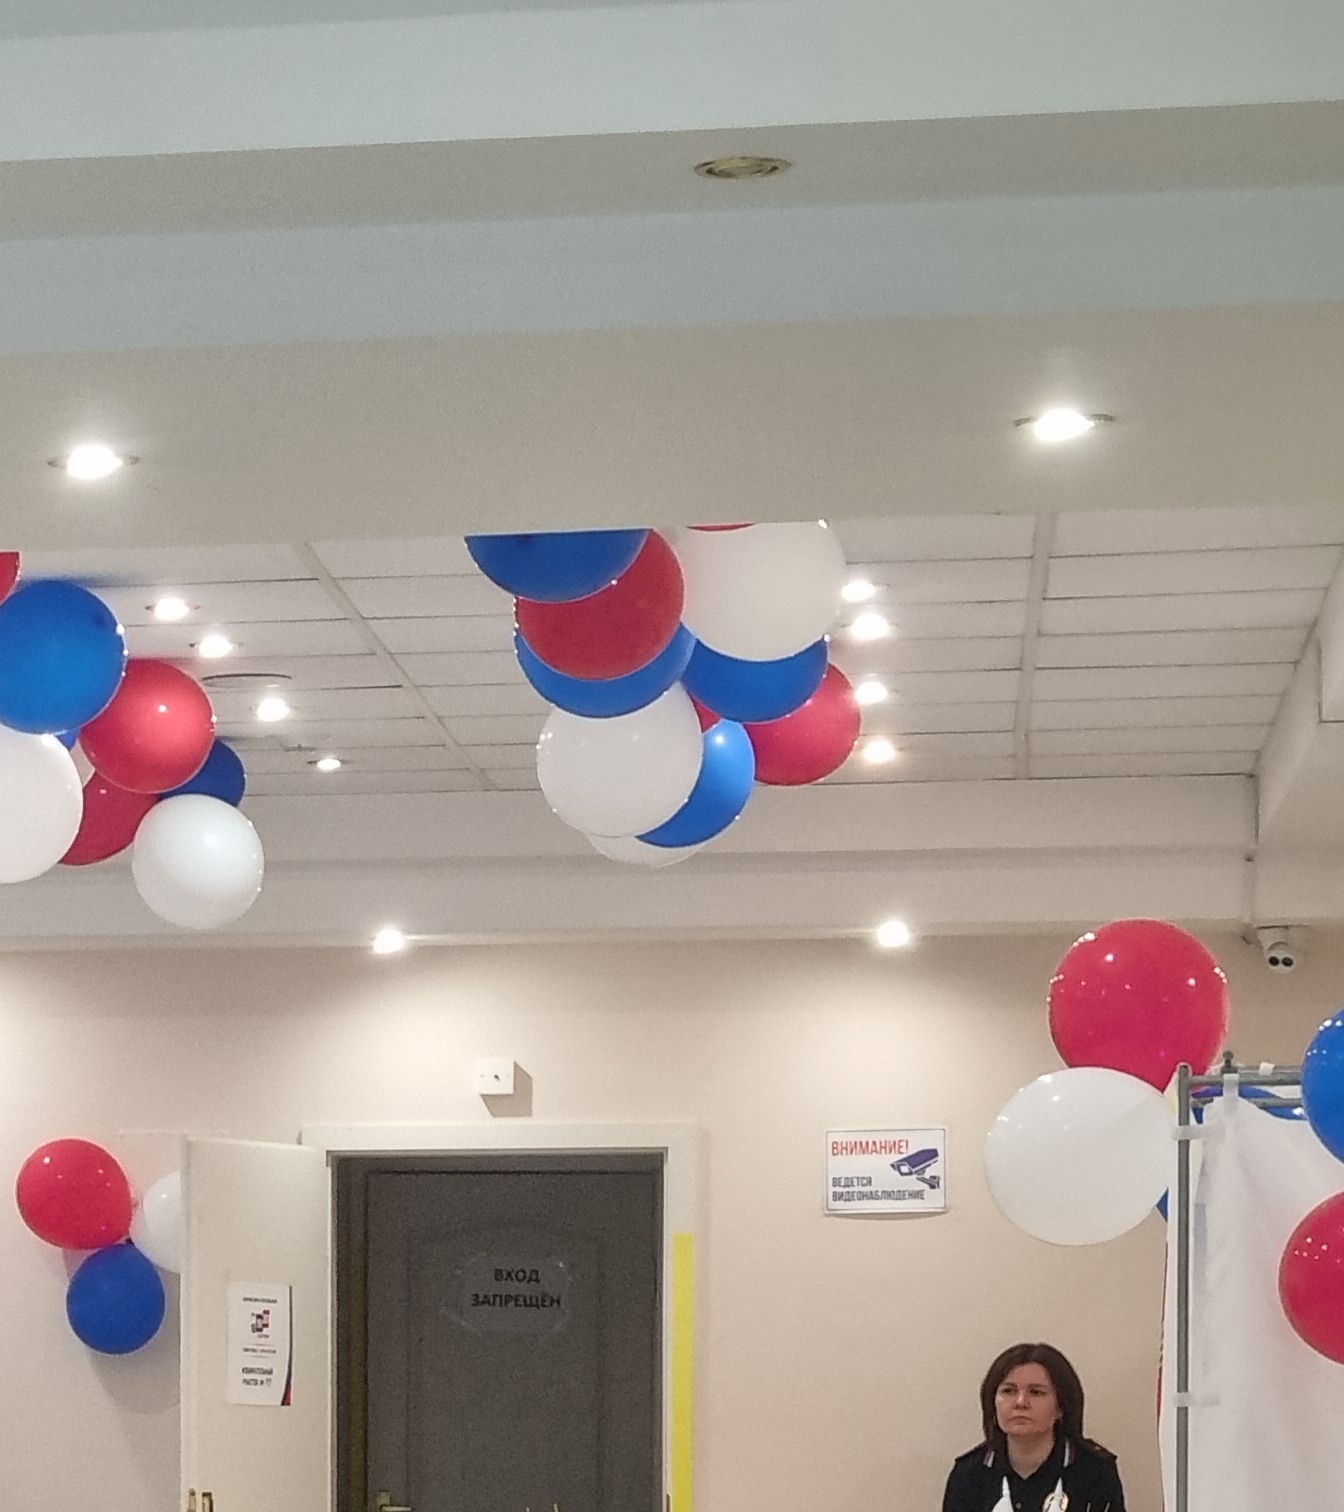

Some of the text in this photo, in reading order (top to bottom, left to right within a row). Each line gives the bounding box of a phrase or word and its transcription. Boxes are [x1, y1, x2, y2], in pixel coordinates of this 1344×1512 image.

[831, 1139, 910, 1157] ВНИМАНИЕ!
[832, 1176, 873, 1189] ВЕДЕТСЯ
[832, 1189, 926, 1203] ВИДЕОНАБЛЮДЕНИЕ
[493, 1268, 541, 1285] ВХОД
[471, 1291, 562, 1310] ЗАПРЕЩЁН
